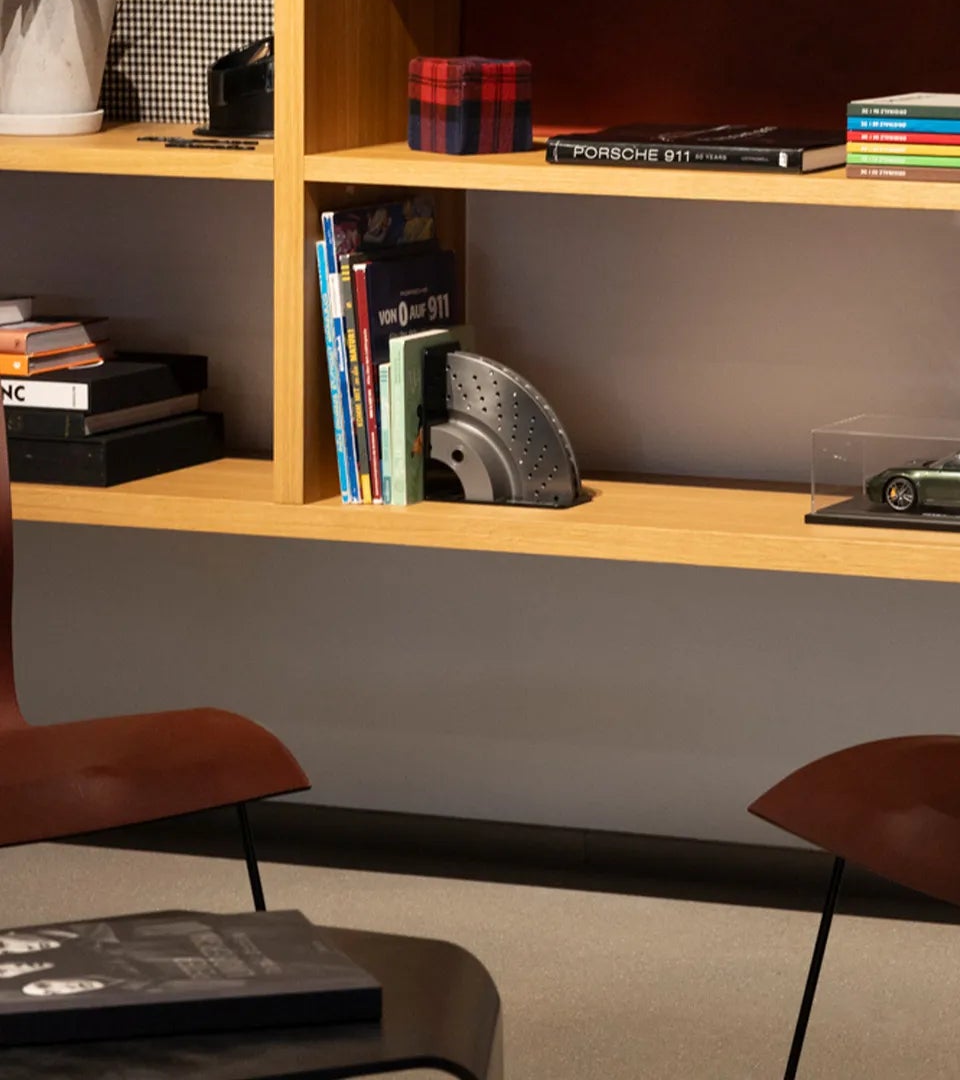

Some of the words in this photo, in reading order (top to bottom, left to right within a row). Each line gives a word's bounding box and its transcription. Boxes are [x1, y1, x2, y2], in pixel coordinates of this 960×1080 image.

[572, 146, 659, 162] PORSCHE
[664, 149, 691, 163] 911
[378, 307, 398, 327] VON
[398, 301, 409, 327] 0
[409, 302, 426, 321] AUF
[427, 293, 450, 321] 911
